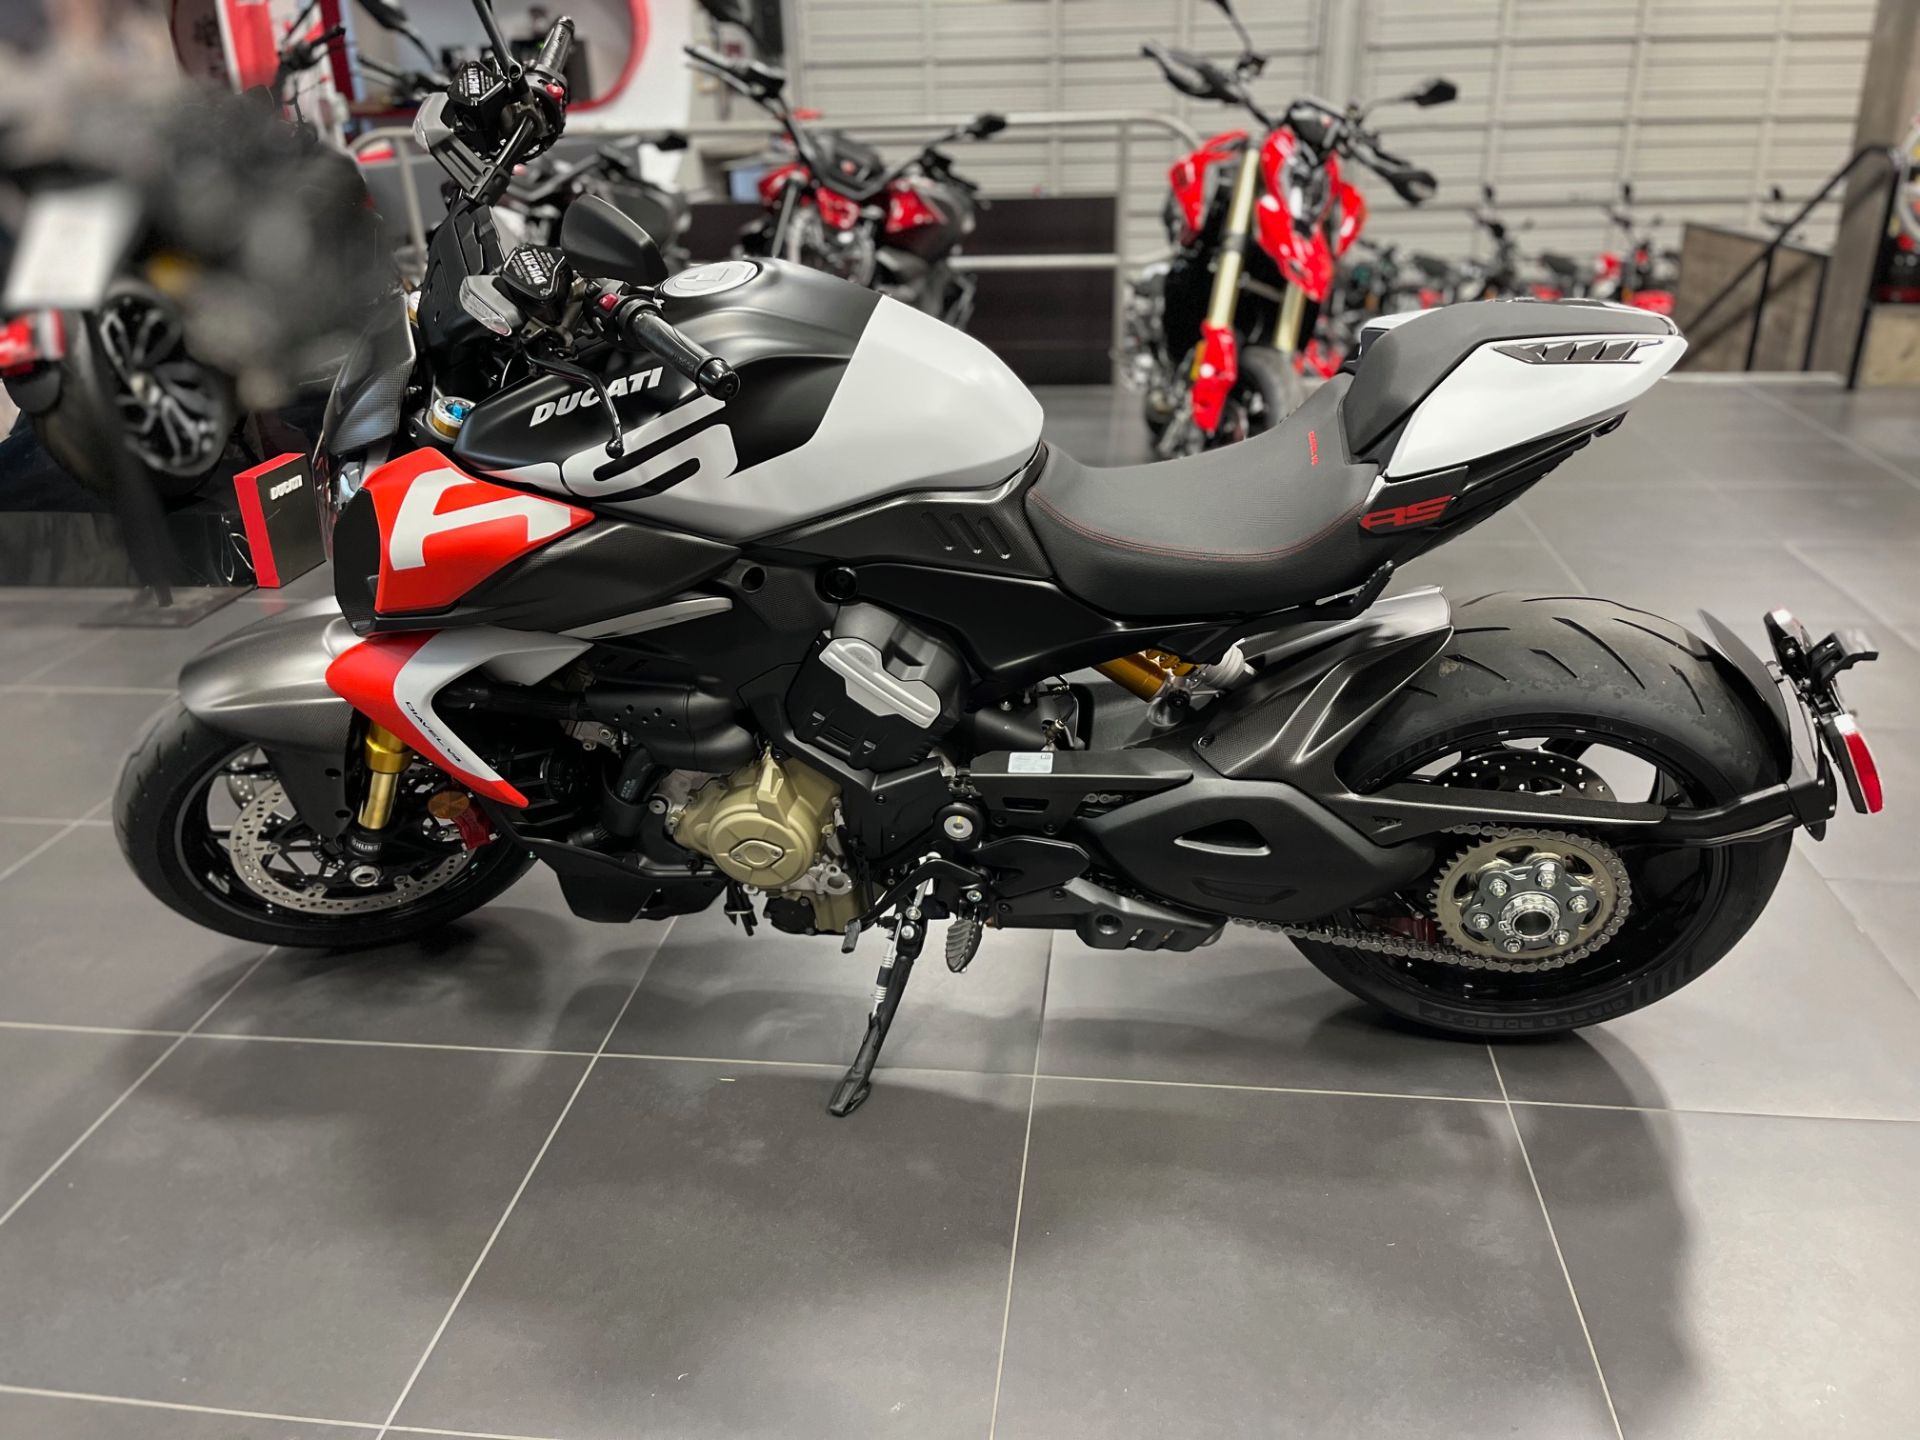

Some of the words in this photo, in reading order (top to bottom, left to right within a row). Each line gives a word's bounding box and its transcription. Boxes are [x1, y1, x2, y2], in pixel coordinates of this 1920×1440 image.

[467, 67, 480, 94] DUCATI
[519, 250, 548, 285] DUCATI
[529, 366, 663, 428] DUCATI
[269, 473, 303, 501] DUCATI
[404, 701, 445, 747] DIAVEL
